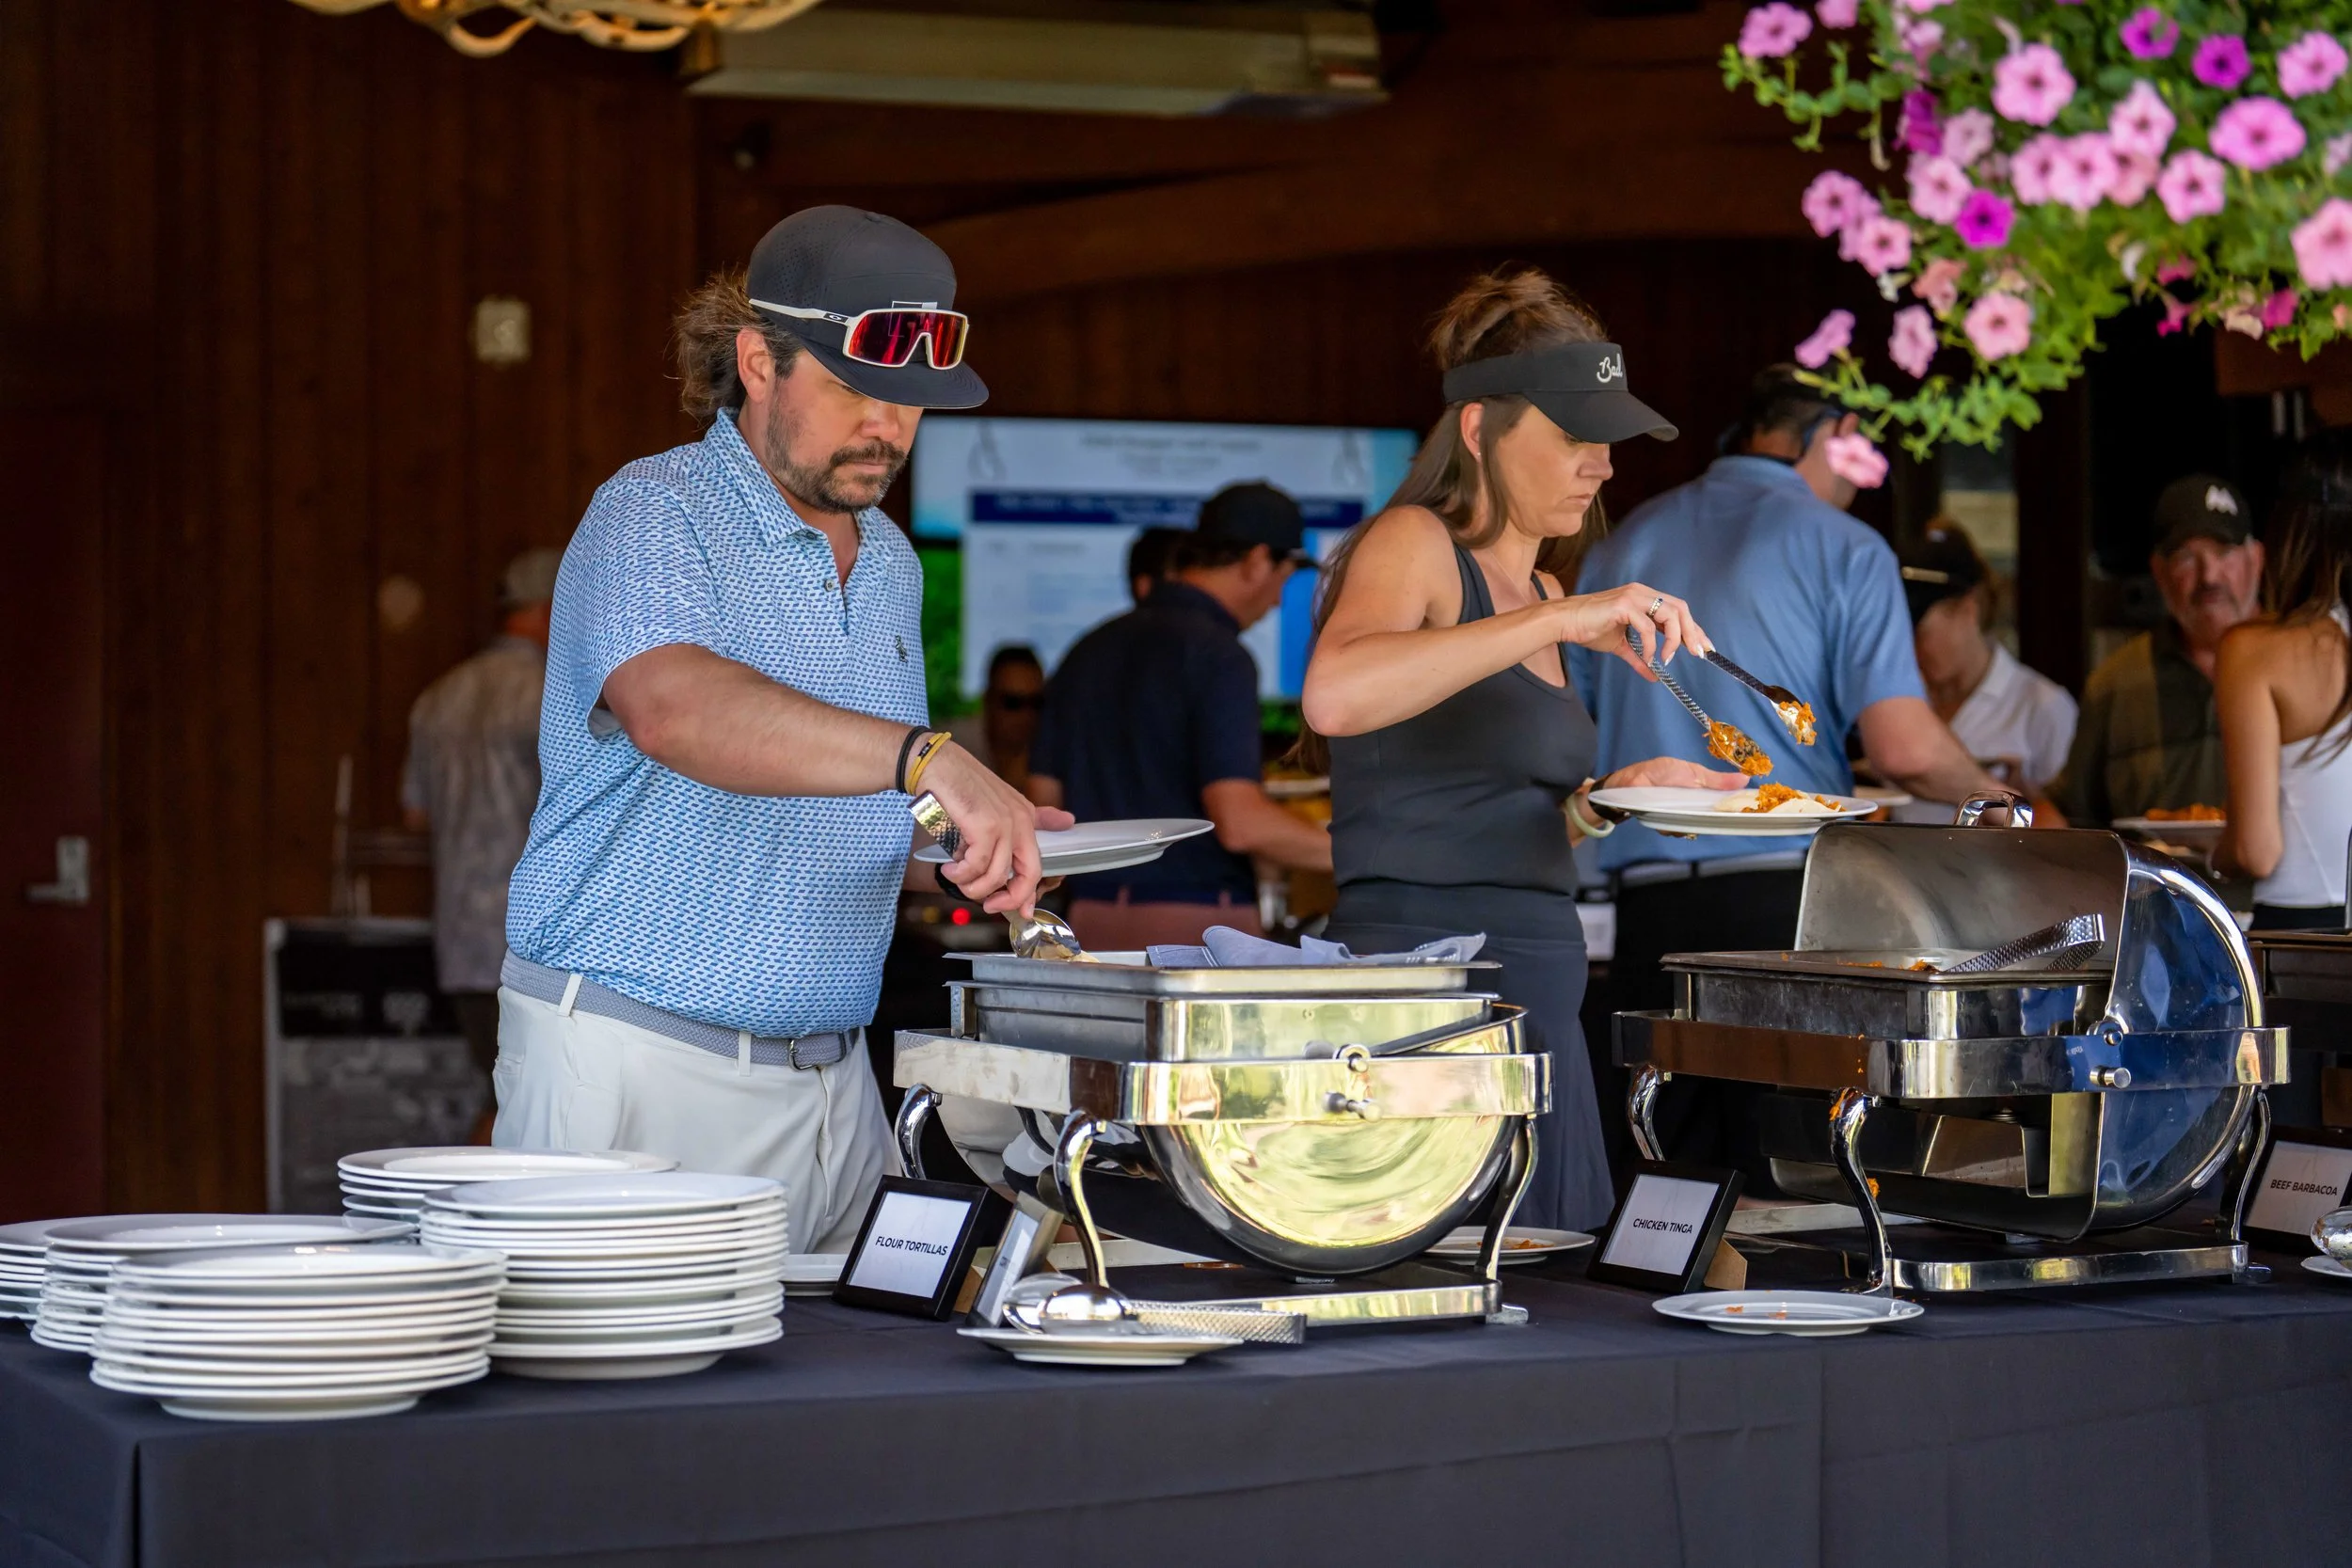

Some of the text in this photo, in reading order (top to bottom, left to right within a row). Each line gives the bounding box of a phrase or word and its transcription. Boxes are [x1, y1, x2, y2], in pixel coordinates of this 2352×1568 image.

[2270, 1179, 2338, 1196] BEEF BARBACOA
[1633, 1218, 1692, 1234] CHICKEN TINGA
[876, 1236, 948, 1256] FLOUR TORTILLAS
